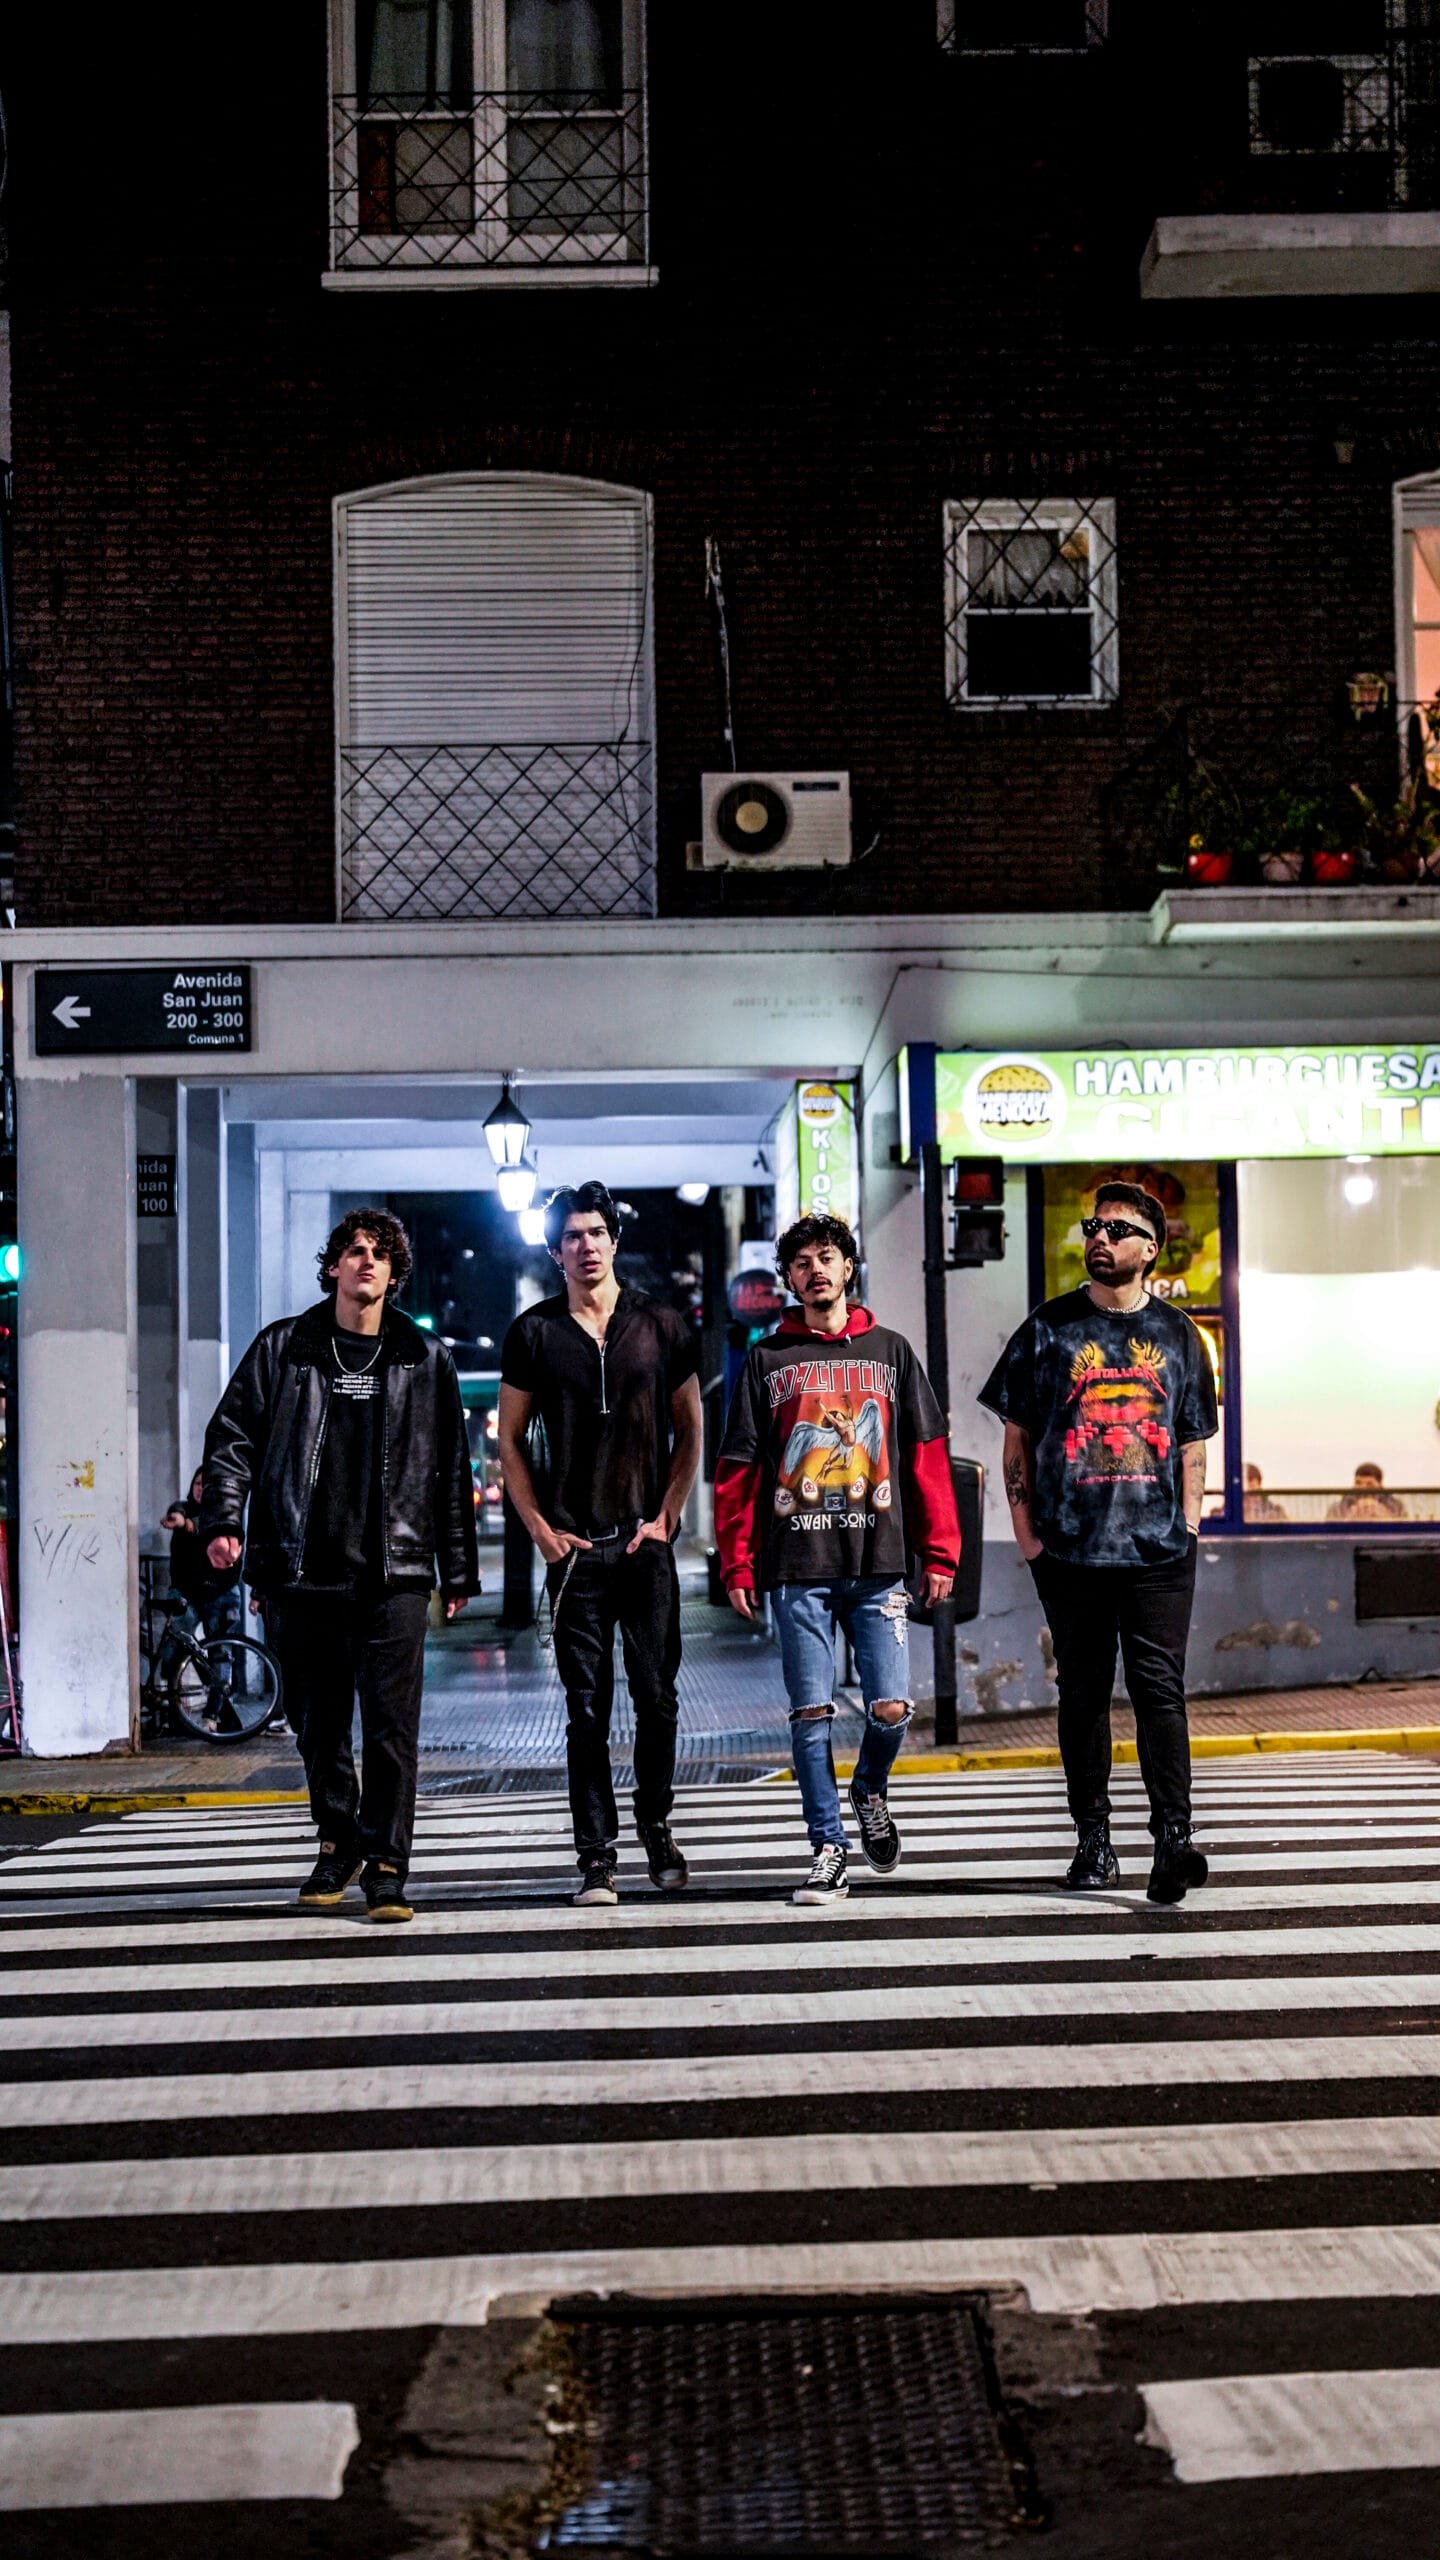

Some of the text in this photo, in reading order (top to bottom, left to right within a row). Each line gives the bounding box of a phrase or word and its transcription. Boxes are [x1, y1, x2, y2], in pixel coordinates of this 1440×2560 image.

[173, 972, 242, 989] Avenida
[162, 991, 243, 1008] San Juan
[167, 1013, 198, 1029] 200
[213, 1012, 244, 1028] 300
[188, 1033, 244, 1044] Comuna 1
[141, 1198, 168, 1212] 100
[790, 1513, 876, 1531] SWAN SONG
